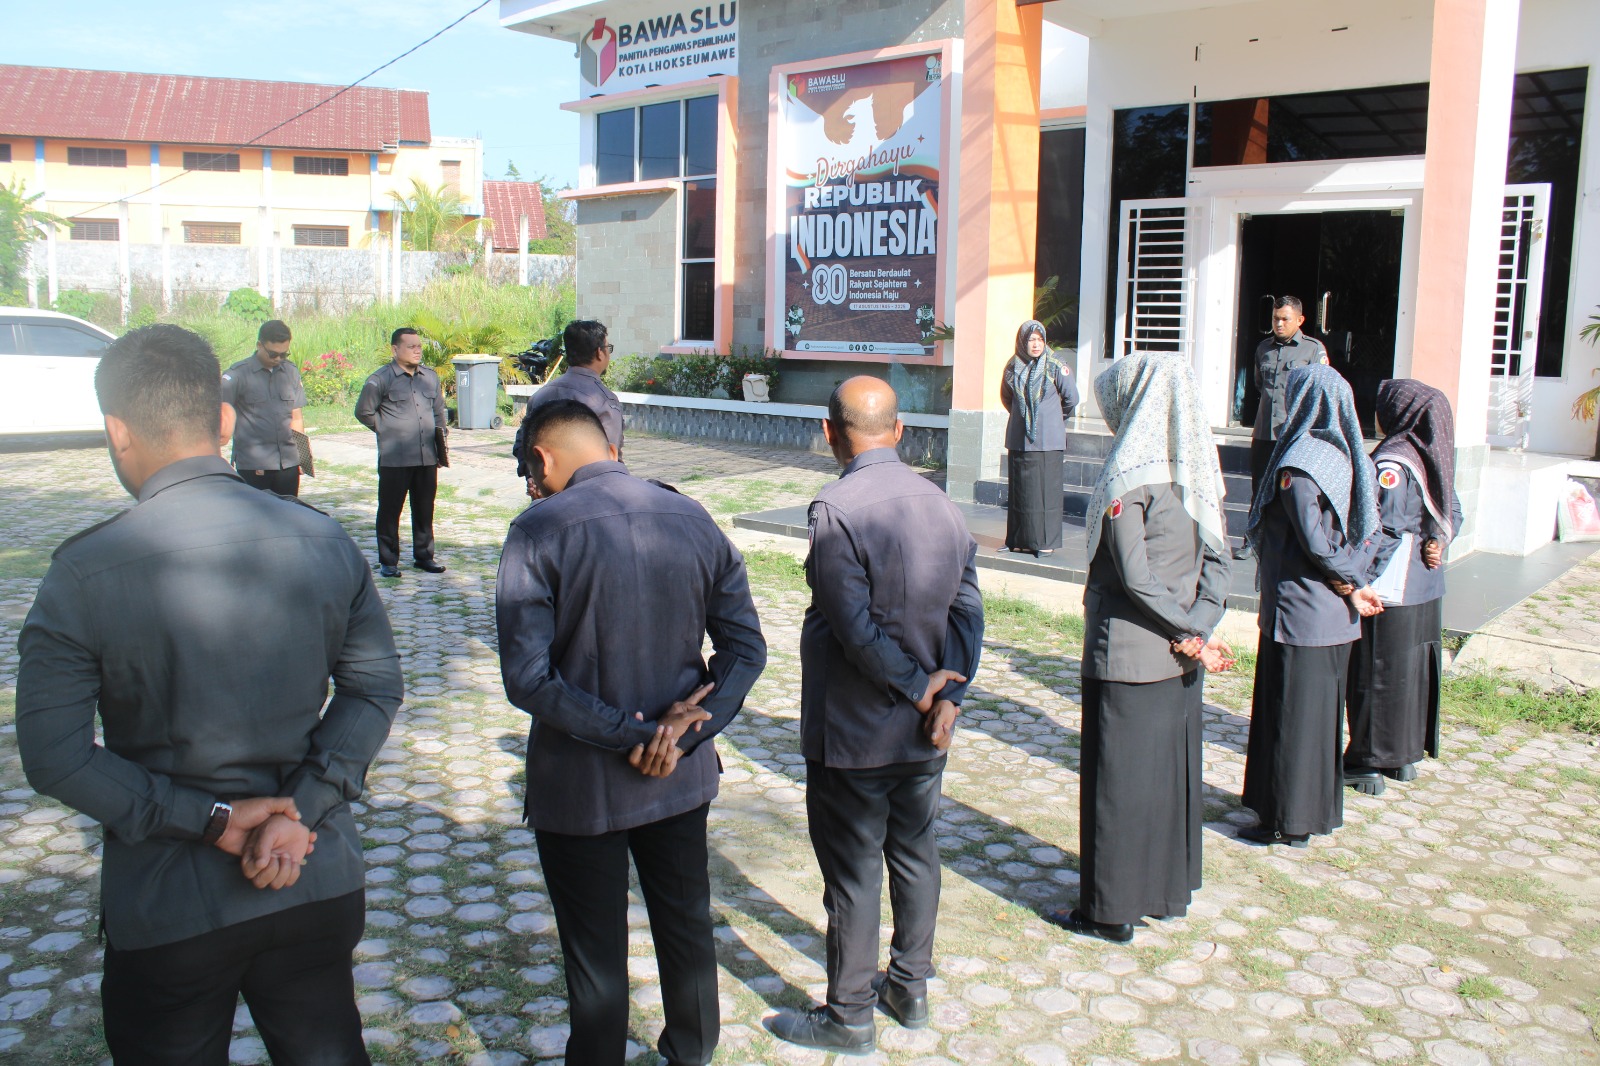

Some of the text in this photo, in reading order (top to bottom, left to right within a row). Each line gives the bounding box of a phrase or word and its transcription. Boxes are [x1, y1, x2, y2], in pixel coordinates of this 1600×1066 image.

[618, 1, 737, 47] BAWASLU
[618, 32, 736, 63] PANITIA PENGAWAS PEMILIHAN
[618, 47, 736, 77] KOTA LHOKSEUMAWE
[808, 73, 846, 87] BAWASLU
[815, 144, 916, 188] Dirgahayu
[804, 179, 922, 209] REPUBLIK
[790, 208, 937, 258] INDONESIA
[812, 263, 848, 305] 80
[849, 268, 912, 278] Bersatu Berdaulat
[849, 279, 908, 291] Rakyat Sejahtera
[849, 290, 899, 301] Indonesia Maju
